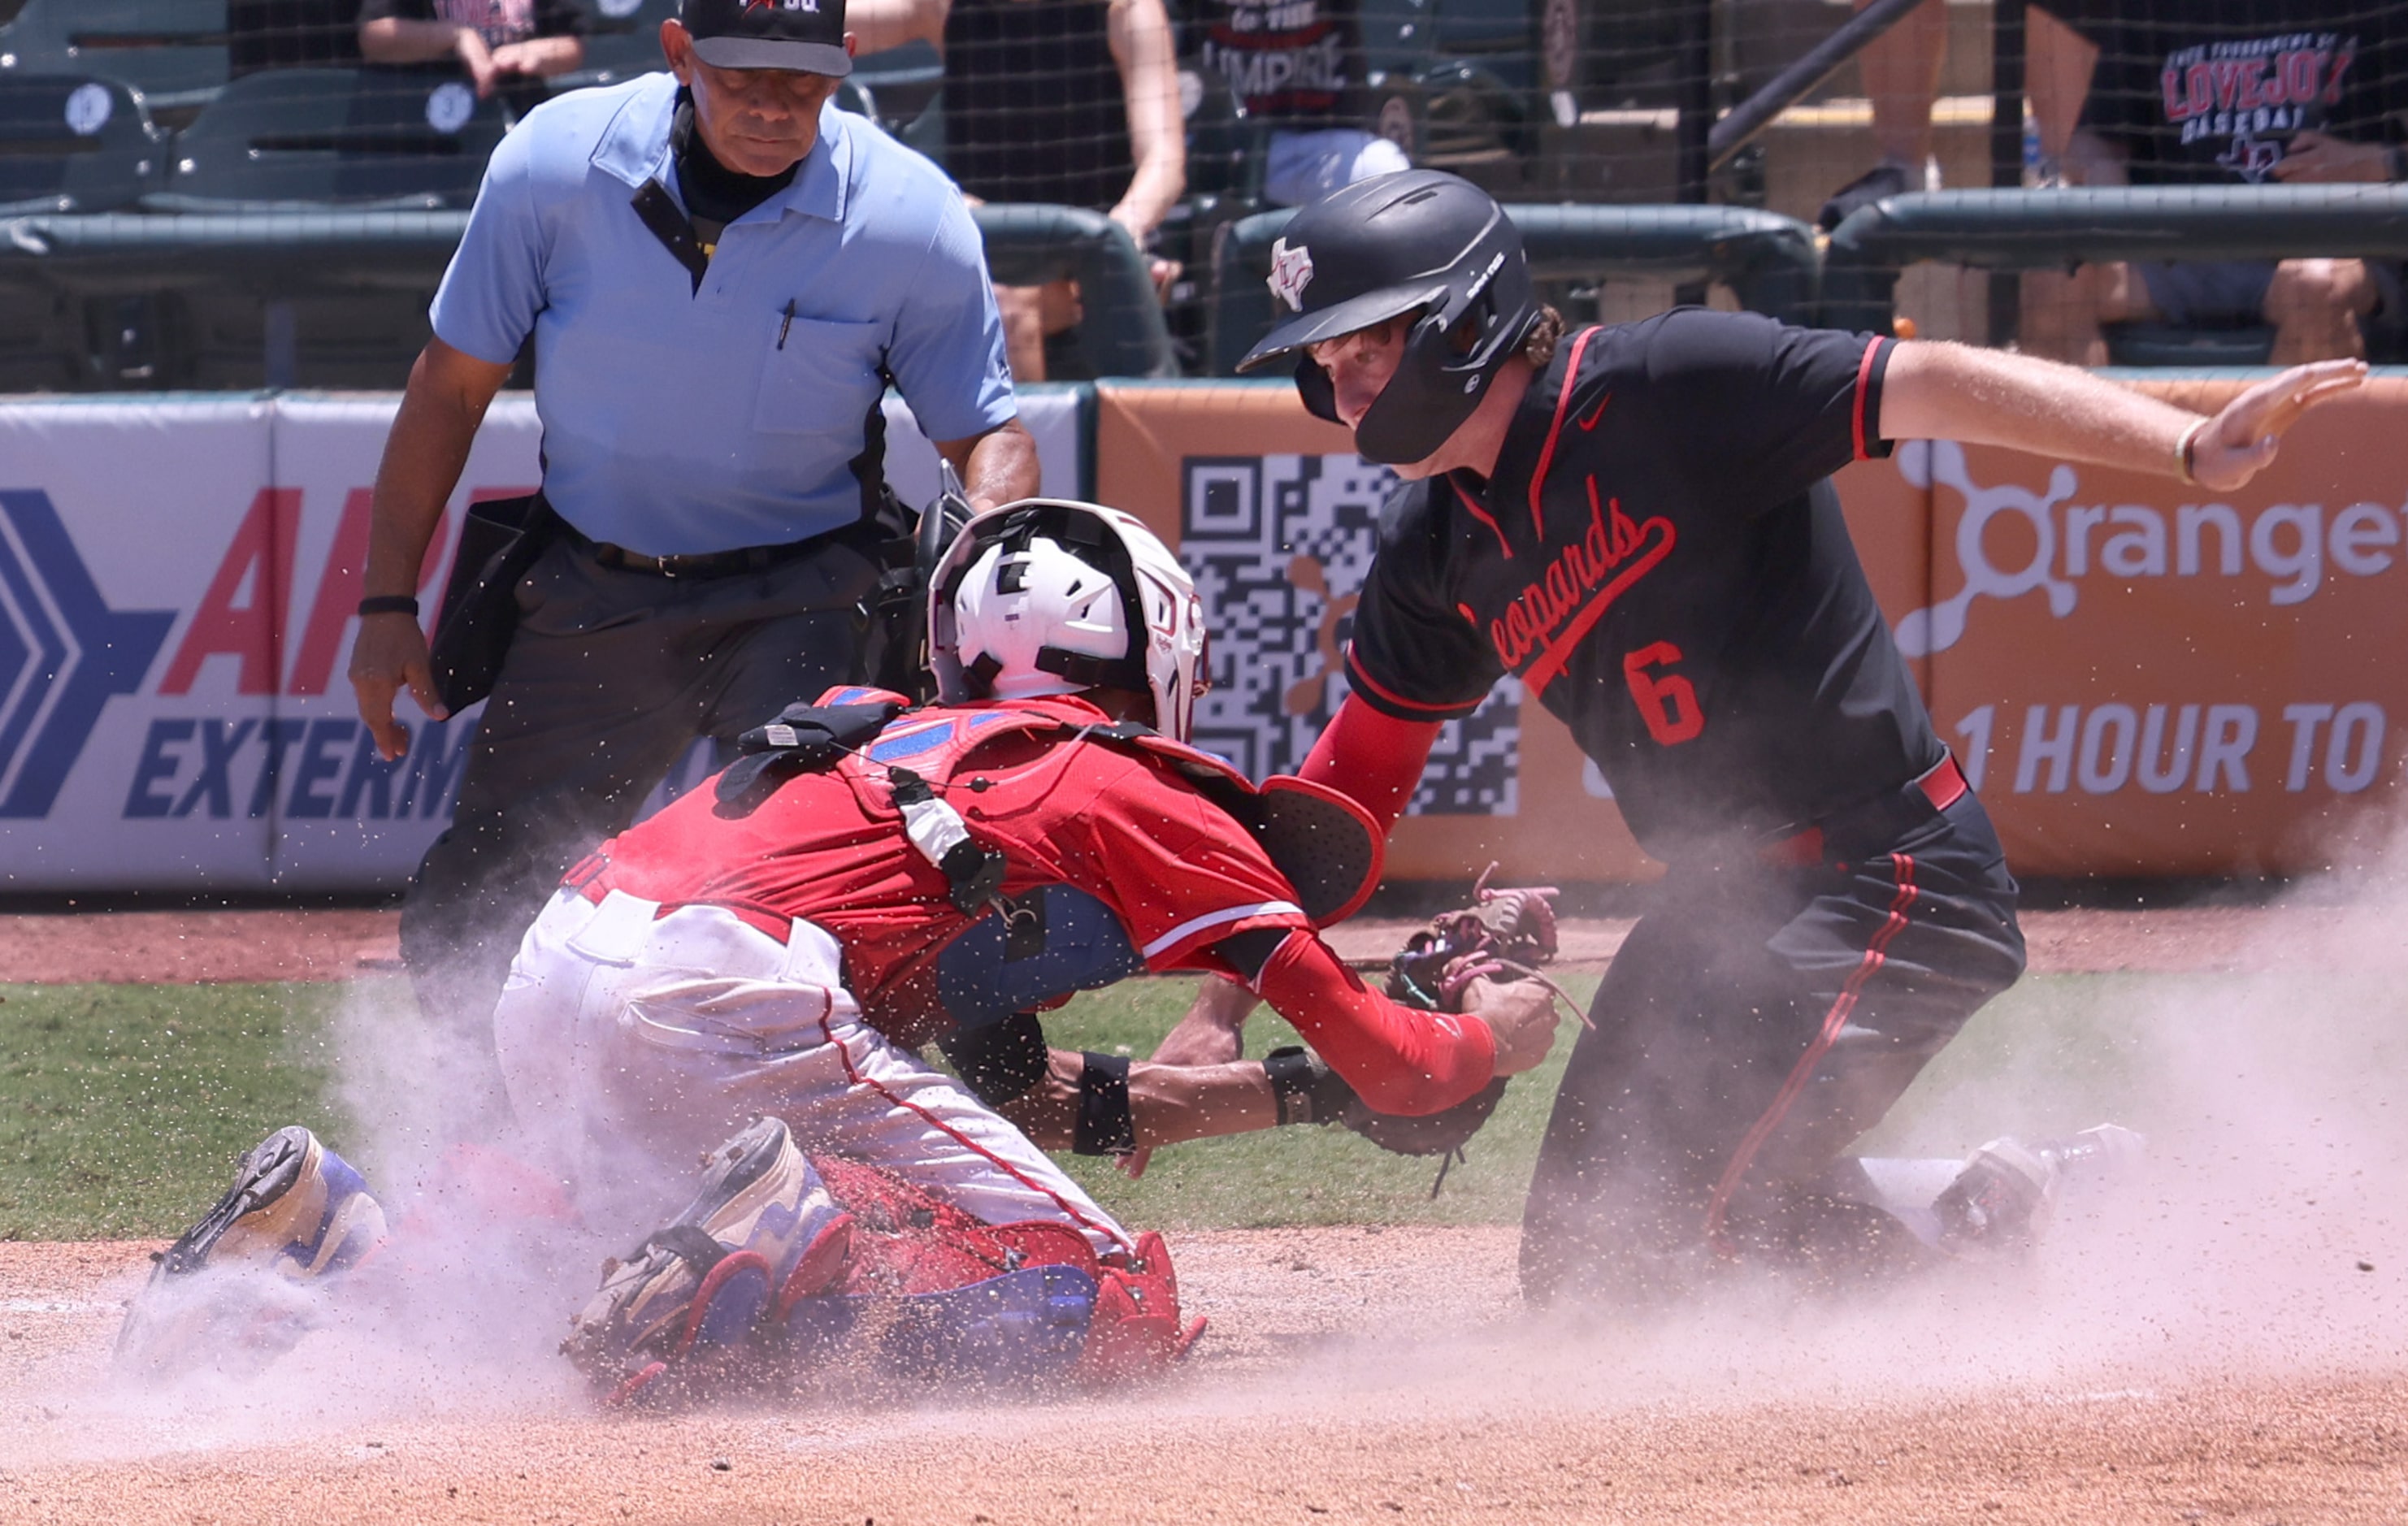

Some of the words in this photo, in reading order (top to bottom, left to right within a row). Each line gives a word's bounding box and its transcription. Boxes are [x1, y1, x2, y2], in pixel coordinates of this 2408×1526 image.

[156, 486, 543, 696] AP
[1457, 474, 1677, 676] eopards
[1955, 465, 2408, 618] Orange
[1624, 640, 1705, 746] 6
[1955, 705, 1995, 794] 1
[2014, 704, 2259, 795] HOUR
[2282, 702, 2387, 794] TO
